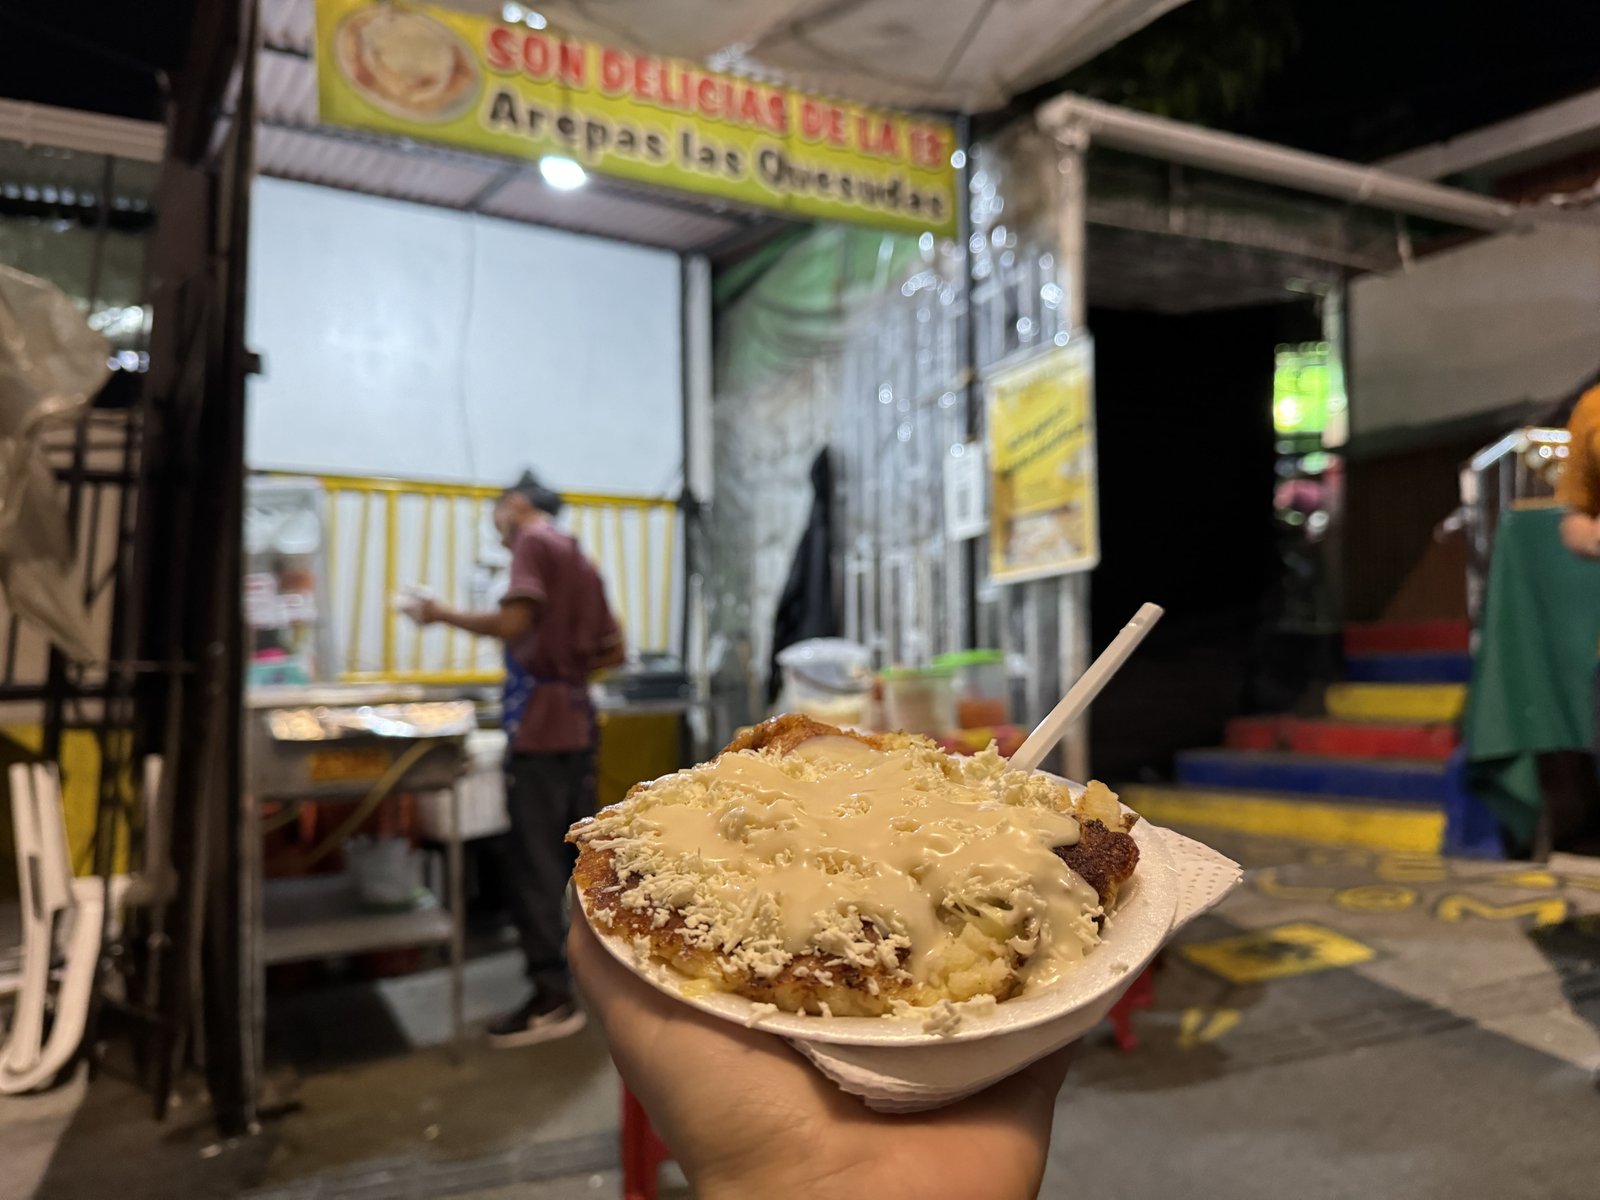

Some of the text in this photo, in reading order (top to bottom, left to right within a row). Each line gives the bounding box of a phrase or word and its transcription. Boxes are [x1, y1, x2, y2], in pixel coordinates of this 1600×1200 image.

[485, 26, 587, 88] SON
[600, 48, 788, 134] DELICIAS
[802, 98, 846, 147] DE
[856, 113, 899, 156] LA
[489, 90, 663, 160] Arepas
[681, 130, 743, 175] las
